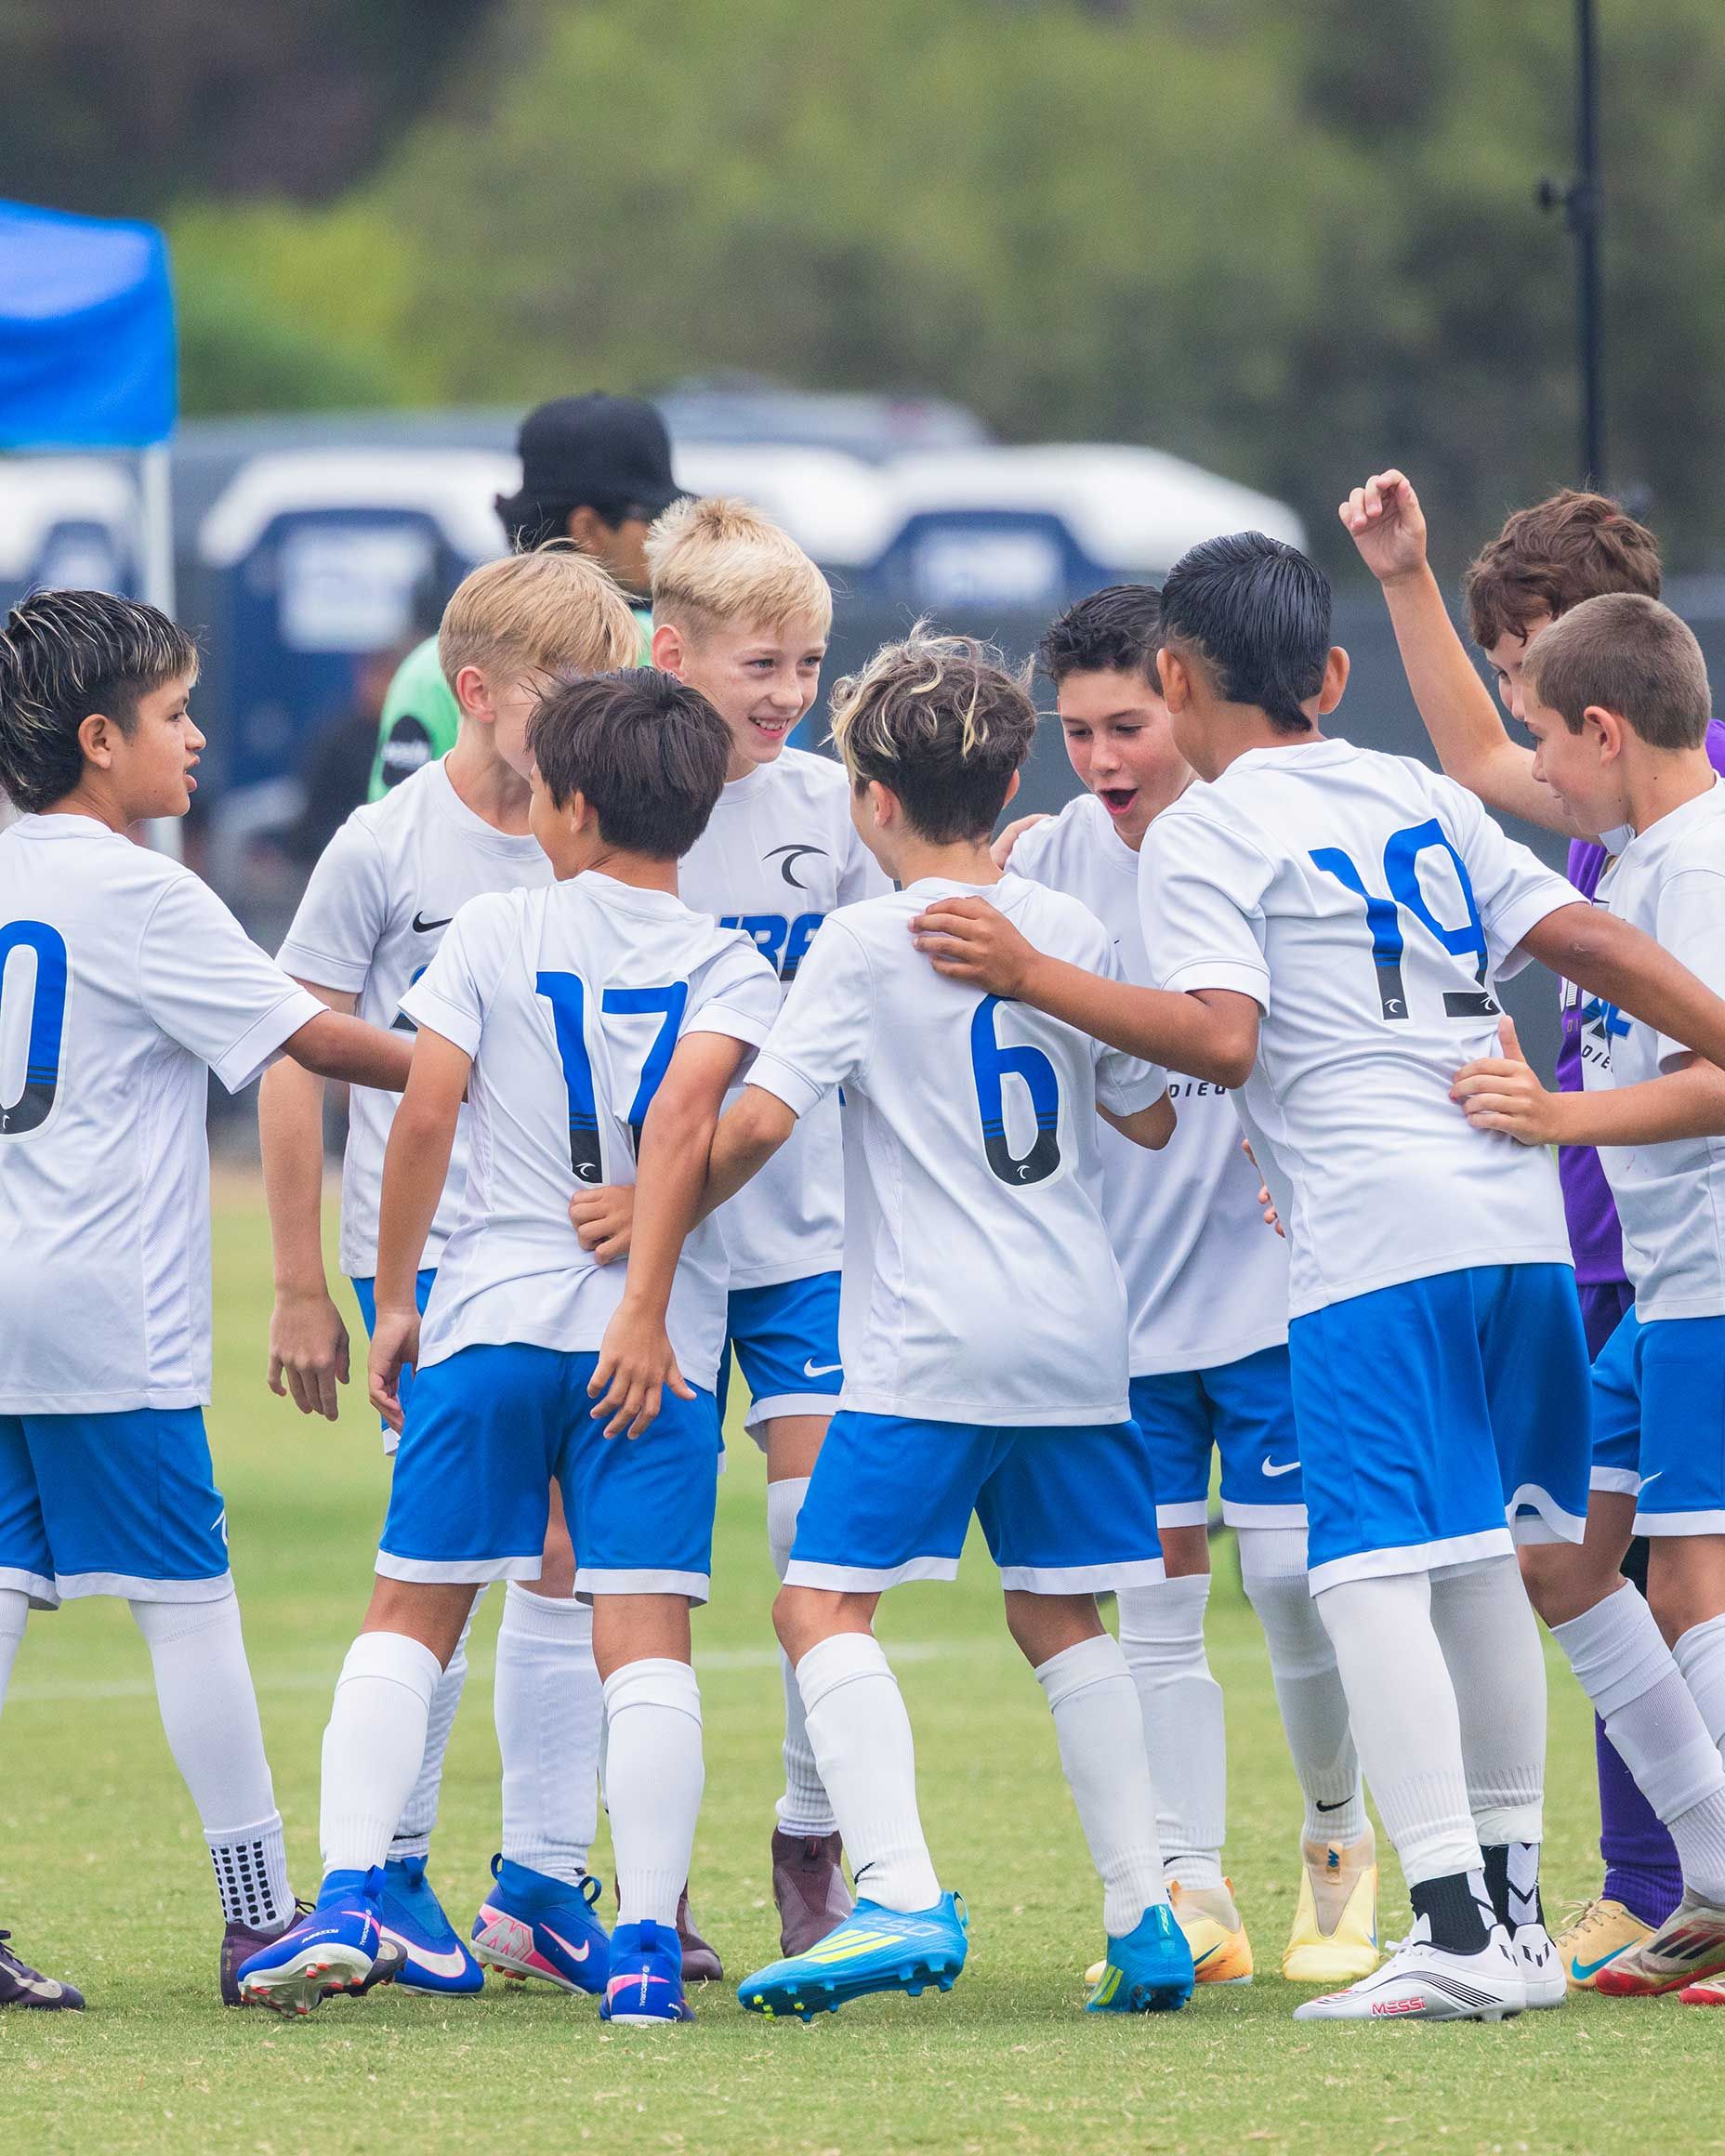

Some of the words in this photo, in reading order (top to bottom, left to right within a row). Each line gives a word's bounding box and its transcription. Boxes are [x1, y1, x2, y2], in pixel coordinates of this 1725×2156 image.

[1307, 817, 1502, 1020] 19
[534, 970, 689, 1184] 17
[970, 993, 1061, 1186] 6
